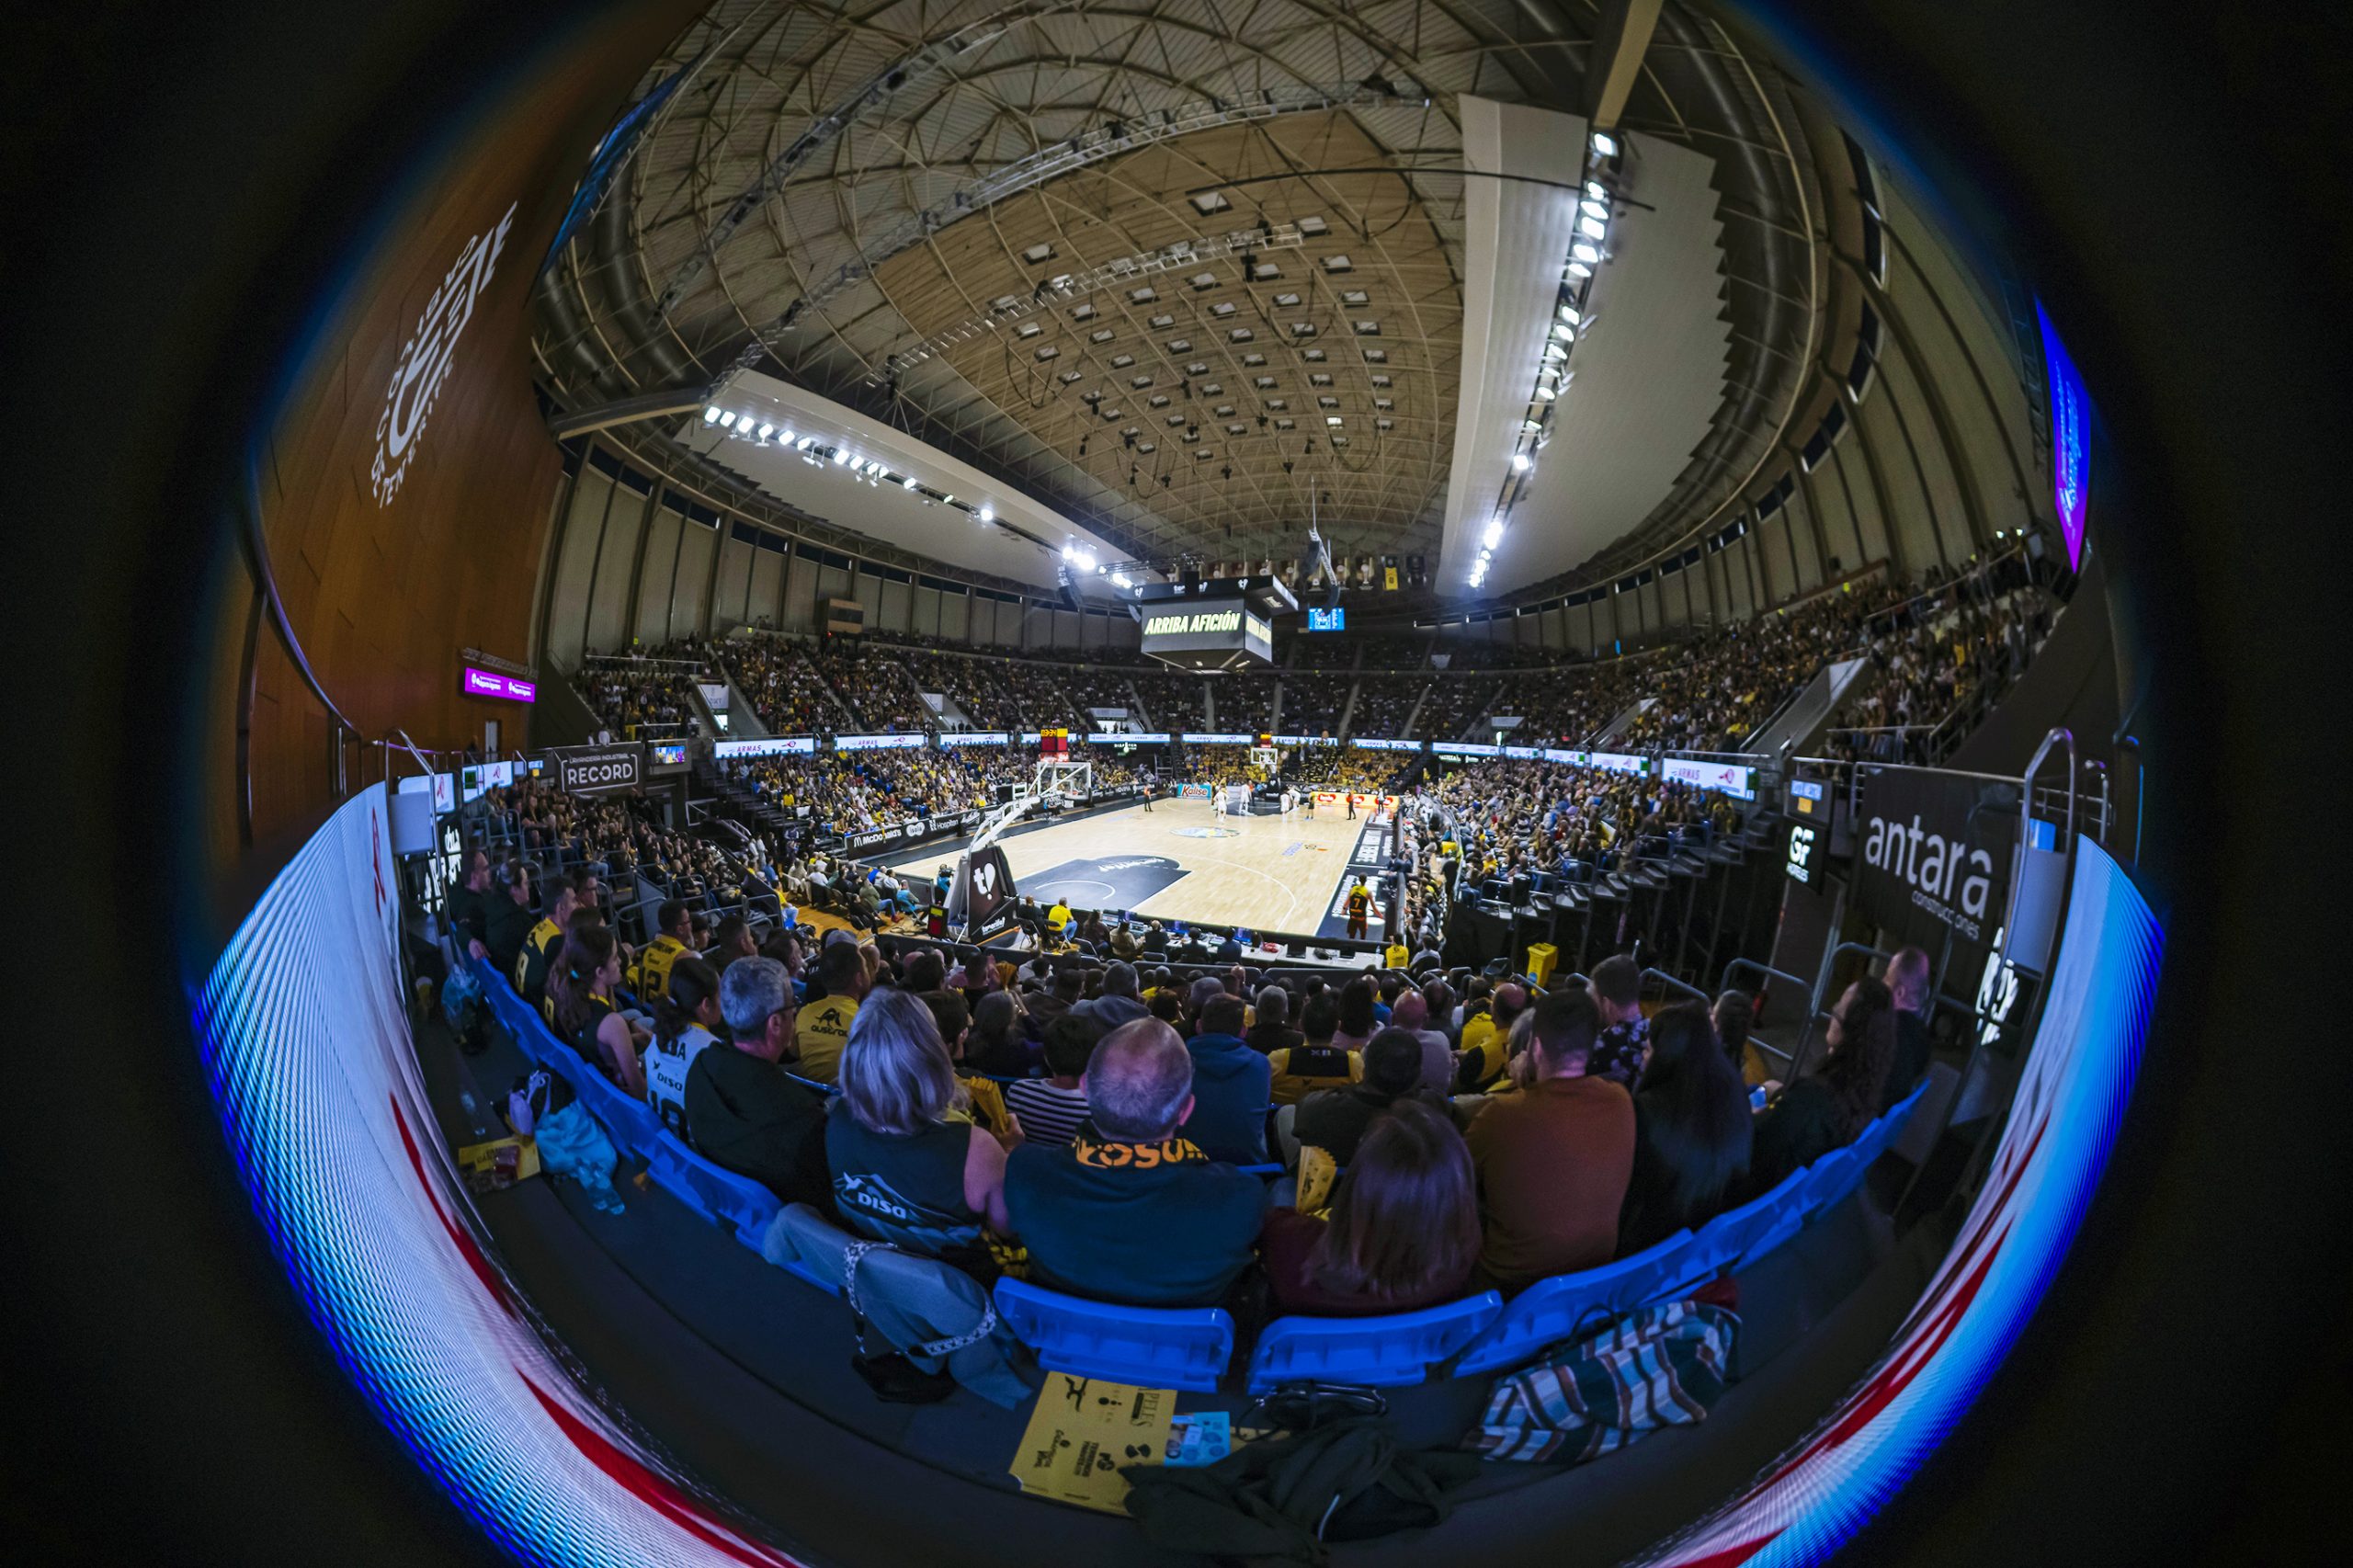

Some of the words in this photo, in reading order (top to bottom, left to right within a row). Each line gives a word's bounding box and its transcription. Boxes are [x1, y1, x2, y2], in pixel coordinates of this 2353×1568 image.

[1144, 615, 1189, 635] ARRIBA
[1188, 609, 1242, 633] AFICIÓN
[736, 744, 762, 753] ARMAS
[567, 763, 633, 786] RECORD
[1678, 767, 1701, 780] ARMAS
[1181, 784, 1208, 797] Kalise
[1864, 813, 1993, 921] antara
[1354, 898, 1360, 909] 7
[1911, 889, 1981, 941] construccones
